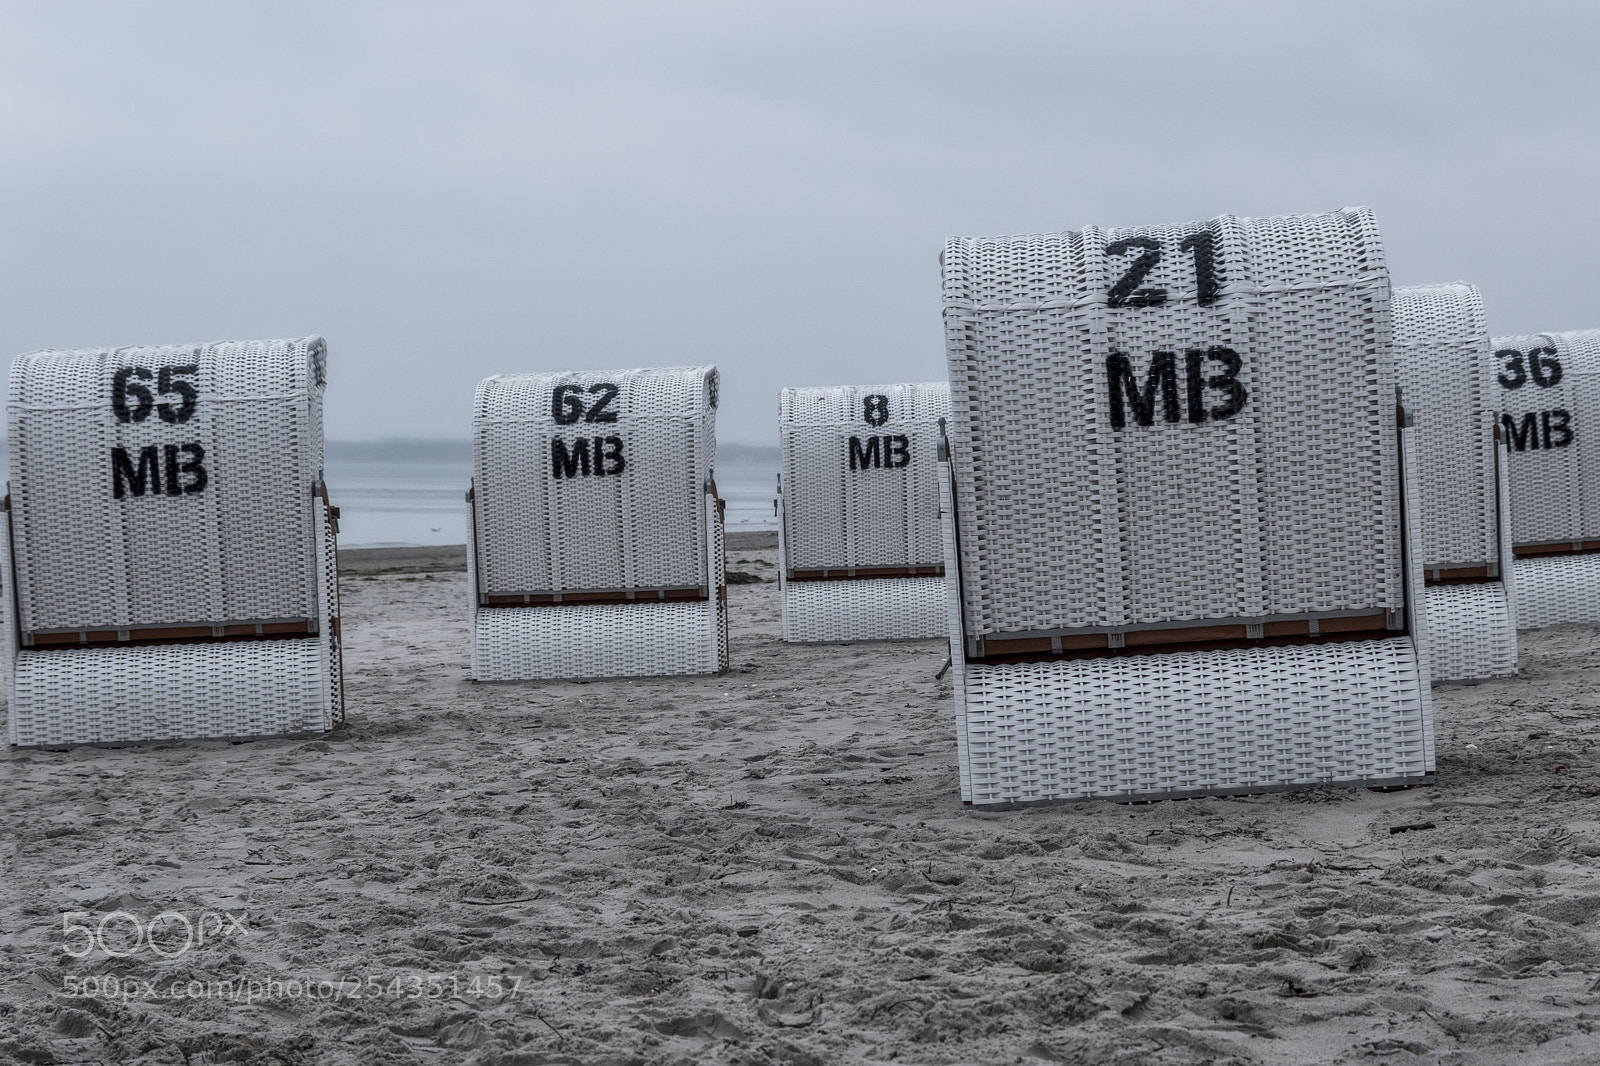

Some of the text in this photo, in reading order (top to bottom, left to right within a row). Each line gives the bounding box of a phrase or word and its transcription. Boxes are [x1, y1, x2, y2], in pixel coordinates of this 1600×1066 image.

[1105, 231, 1219, 307] 21
[1105, 345, 1248, 430] MB
[1495, 348, 1562, 388] 36
[112, 365, 198, 424] 65
[552, 384, 618, 425] 62
[864, 395, 889, 426] 8
[1502, 409, 1574, 453] MB
[111, 440, 208, 501] MB
[551, 436, 627, 479] MB
[849, 435, 910, 471] MB
